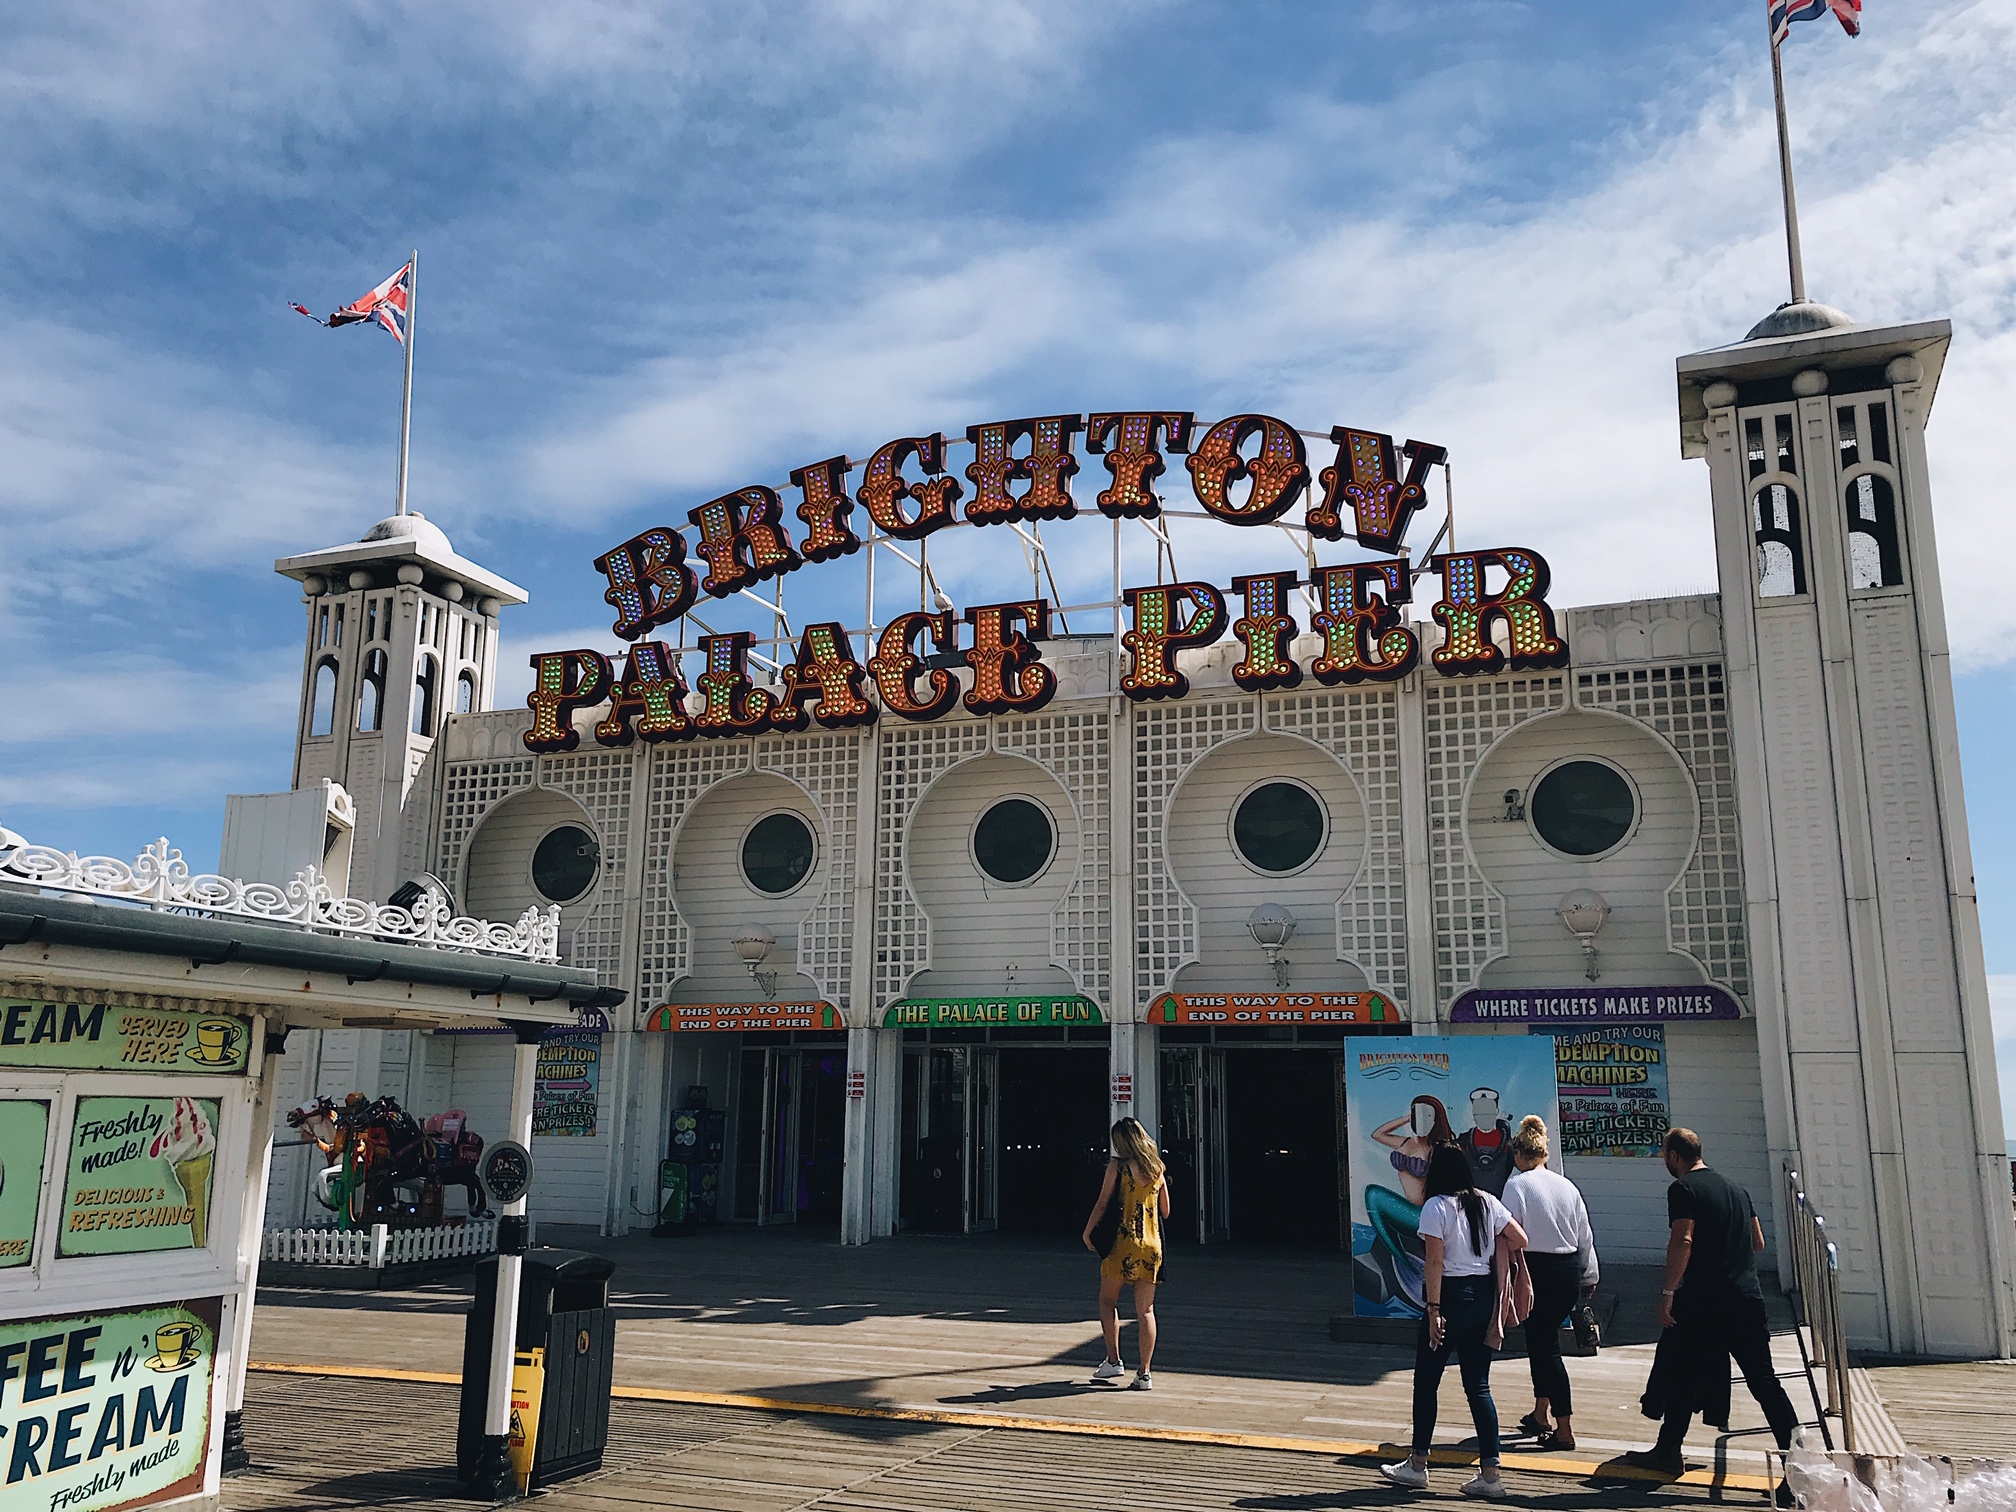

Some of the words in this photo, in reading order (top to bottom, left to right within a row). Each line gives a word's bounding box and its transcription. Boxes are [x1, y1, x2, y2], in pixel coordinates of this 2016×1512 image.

[593, 412, 1448, 641] BRIGHTON
[523, 599, 1057, 753] PALACE
[1121, 547, 1570, 701] PIER
[678, 1007, 711, 1016] THIS
[716, 1006, 753, 1015] WAY
[757, 1006, 780, 1014] TO
[785, 1005, 815, 1014] THE
[1184, 997, 1226, 1006] THIS
[1233, 997, 1280, 1006] WAY
[1285, 996, 1313, 1005] TO
[1321, 996, 1359, 1005] THE
[1475, 999, 1528, 1017] WHERE
[1534, 998, 1597, 1016] TICKETS
[1604, 997, 1650, 1015] MAKE
[1656, 995, 1713, 1014] PRIZES
[894, 1005, 929, 1023] THE
[938, 1003, 1008, 1022] PALACE
[1017, 1002, 1042, 1021] OF
[1051, 1002, 1090, 1020] FUN
[1188, 1012, 1228, 1021] END
[1234, 1011, 1261, 1020] OF
[1266, 1011, 1304, 1020] THE
[1310, 1011, 1356, 1020] PIER
[0, 1004, 105, 1045] EAM
[118, 1014, 189, 1038] SERVED
[679, 1021, 711, 1029] END
[716, 1020, 737, 1028] OF
[742, 1019, 770, 1028] THE
[776, 1019, 811, 1027] PIER
[543, 1037, 562, 1048] AND
[564, 1033, 580, 1044] TRY
[581, 1033, 599, 1045] OUR
[1573, 1031, 1600, 1045] AND
[1604, 1027, 1628, 1039] TRY
[1632, 1026, 1661, 1041] OUR
[121, 1039, 183, 1064] HERE
[537, 1046, 596, 1061] DEMPTION
[1555, 1043, 1659, 1063] DEMPTION
[536, 1064, 587, 1079] ACHINES
[1359, 1053, 1421, 1071] BRIGHTON
[1422, 1053, 1451, 1073] PIER
[1616, 1088, 1658, 1099] HERE
[552, 1103, 595, 1116] TICKETS
[1575, 1100, 1617, 1112] Palace
[1621, 1100, 1635, 1113] of
[1638, 1100, 1664, 1112] Fun
[80, 1104, 163, 1147] Freshly
[532, 1119, 546, 1131] AN
[1561, 1120, 1595, 1133] ERE
[1599, 1116, 1667, 1130] TICKETS
[1561, 1137, 1590, 1149] EAN
[81, 1137, 145, 1174] made!
[74, 1187, 154, 1206] DELICIOUS
[157, 1189, 164, 1200] &
[69, 1204, 195, 1232] REFRESHING
[511, 1400, 530, 1409] UTION
[0, 1374, 189, 1485] REAM
[50, 1464, 126, 1512] Freshly
[130, 1439, 180, 1477] made
